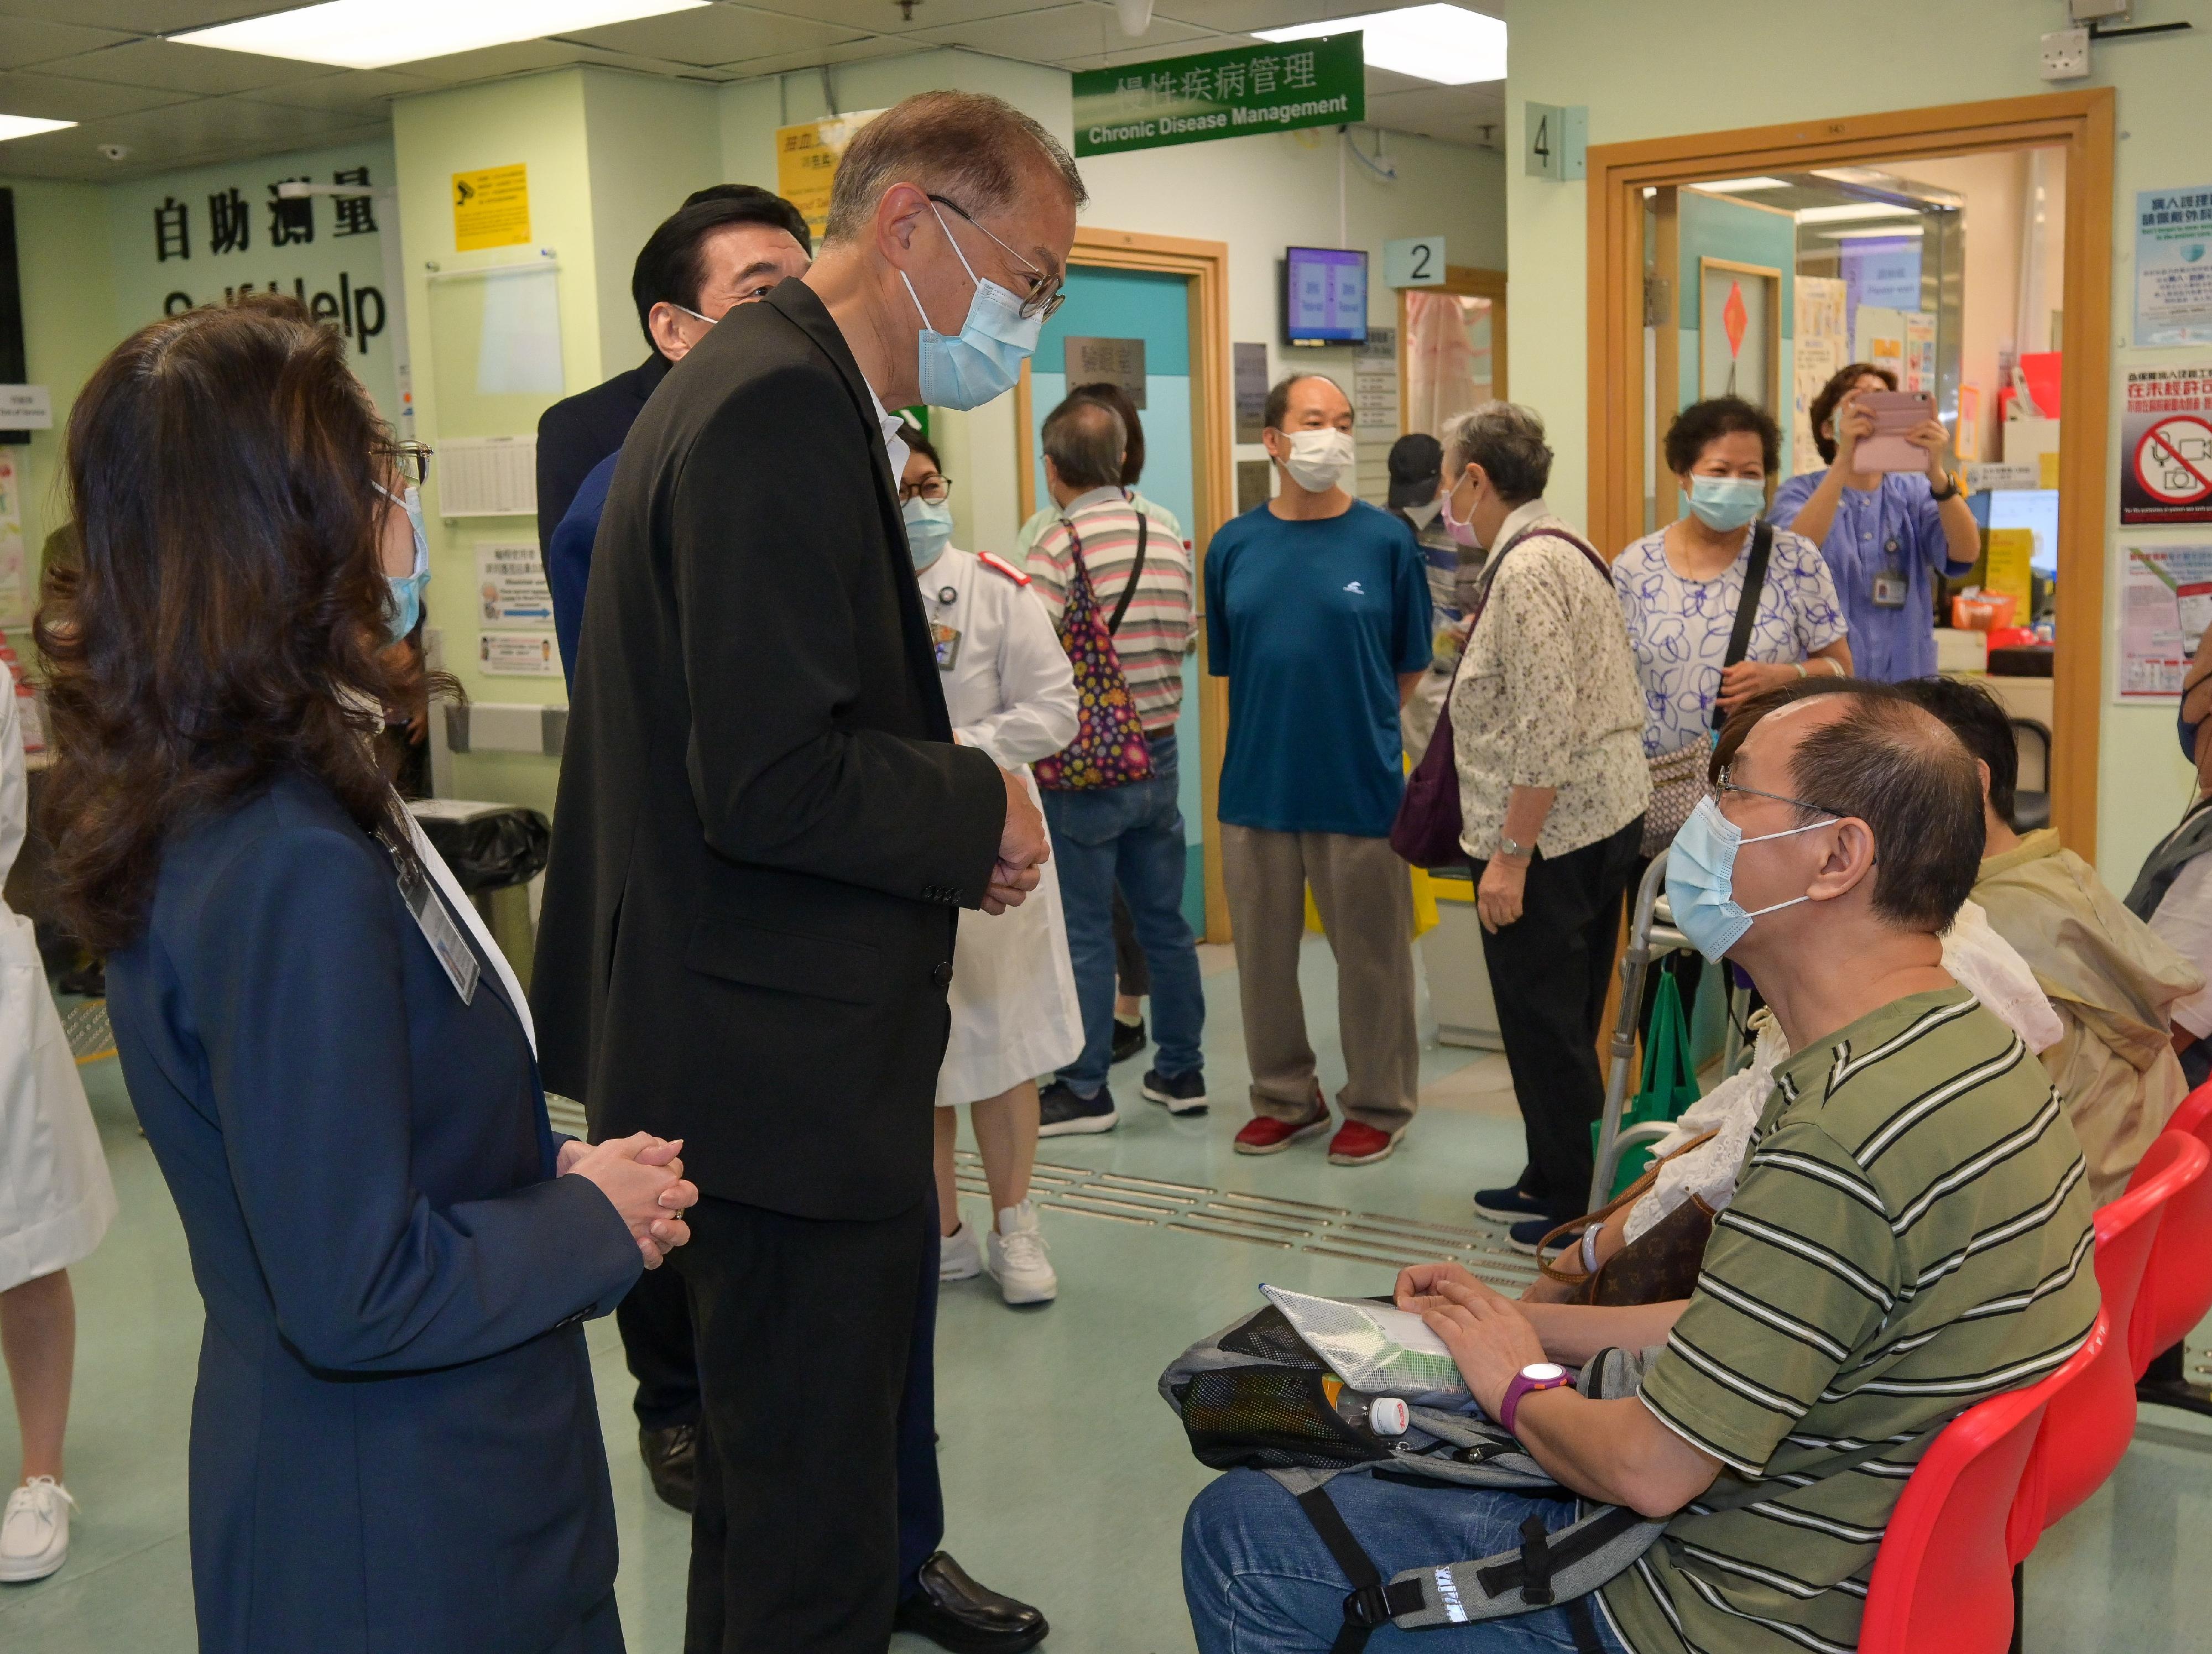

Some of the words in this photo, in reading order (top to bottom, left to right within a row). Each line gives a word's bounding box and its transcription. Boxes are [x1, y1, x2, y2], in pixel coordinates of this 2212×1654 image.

[1114, 50, 1317, 109] 慢性疾病管理
[1088, 121, 1156, 145] Chronic
[1159, 112, 1227, 134] Disease
[1231, 94, 1349, 125] Management
[1534, 114, 1549, 167] 4
[154, 166, 379, 263] 自助測量
[1410, 243, 1432, 280] 2
